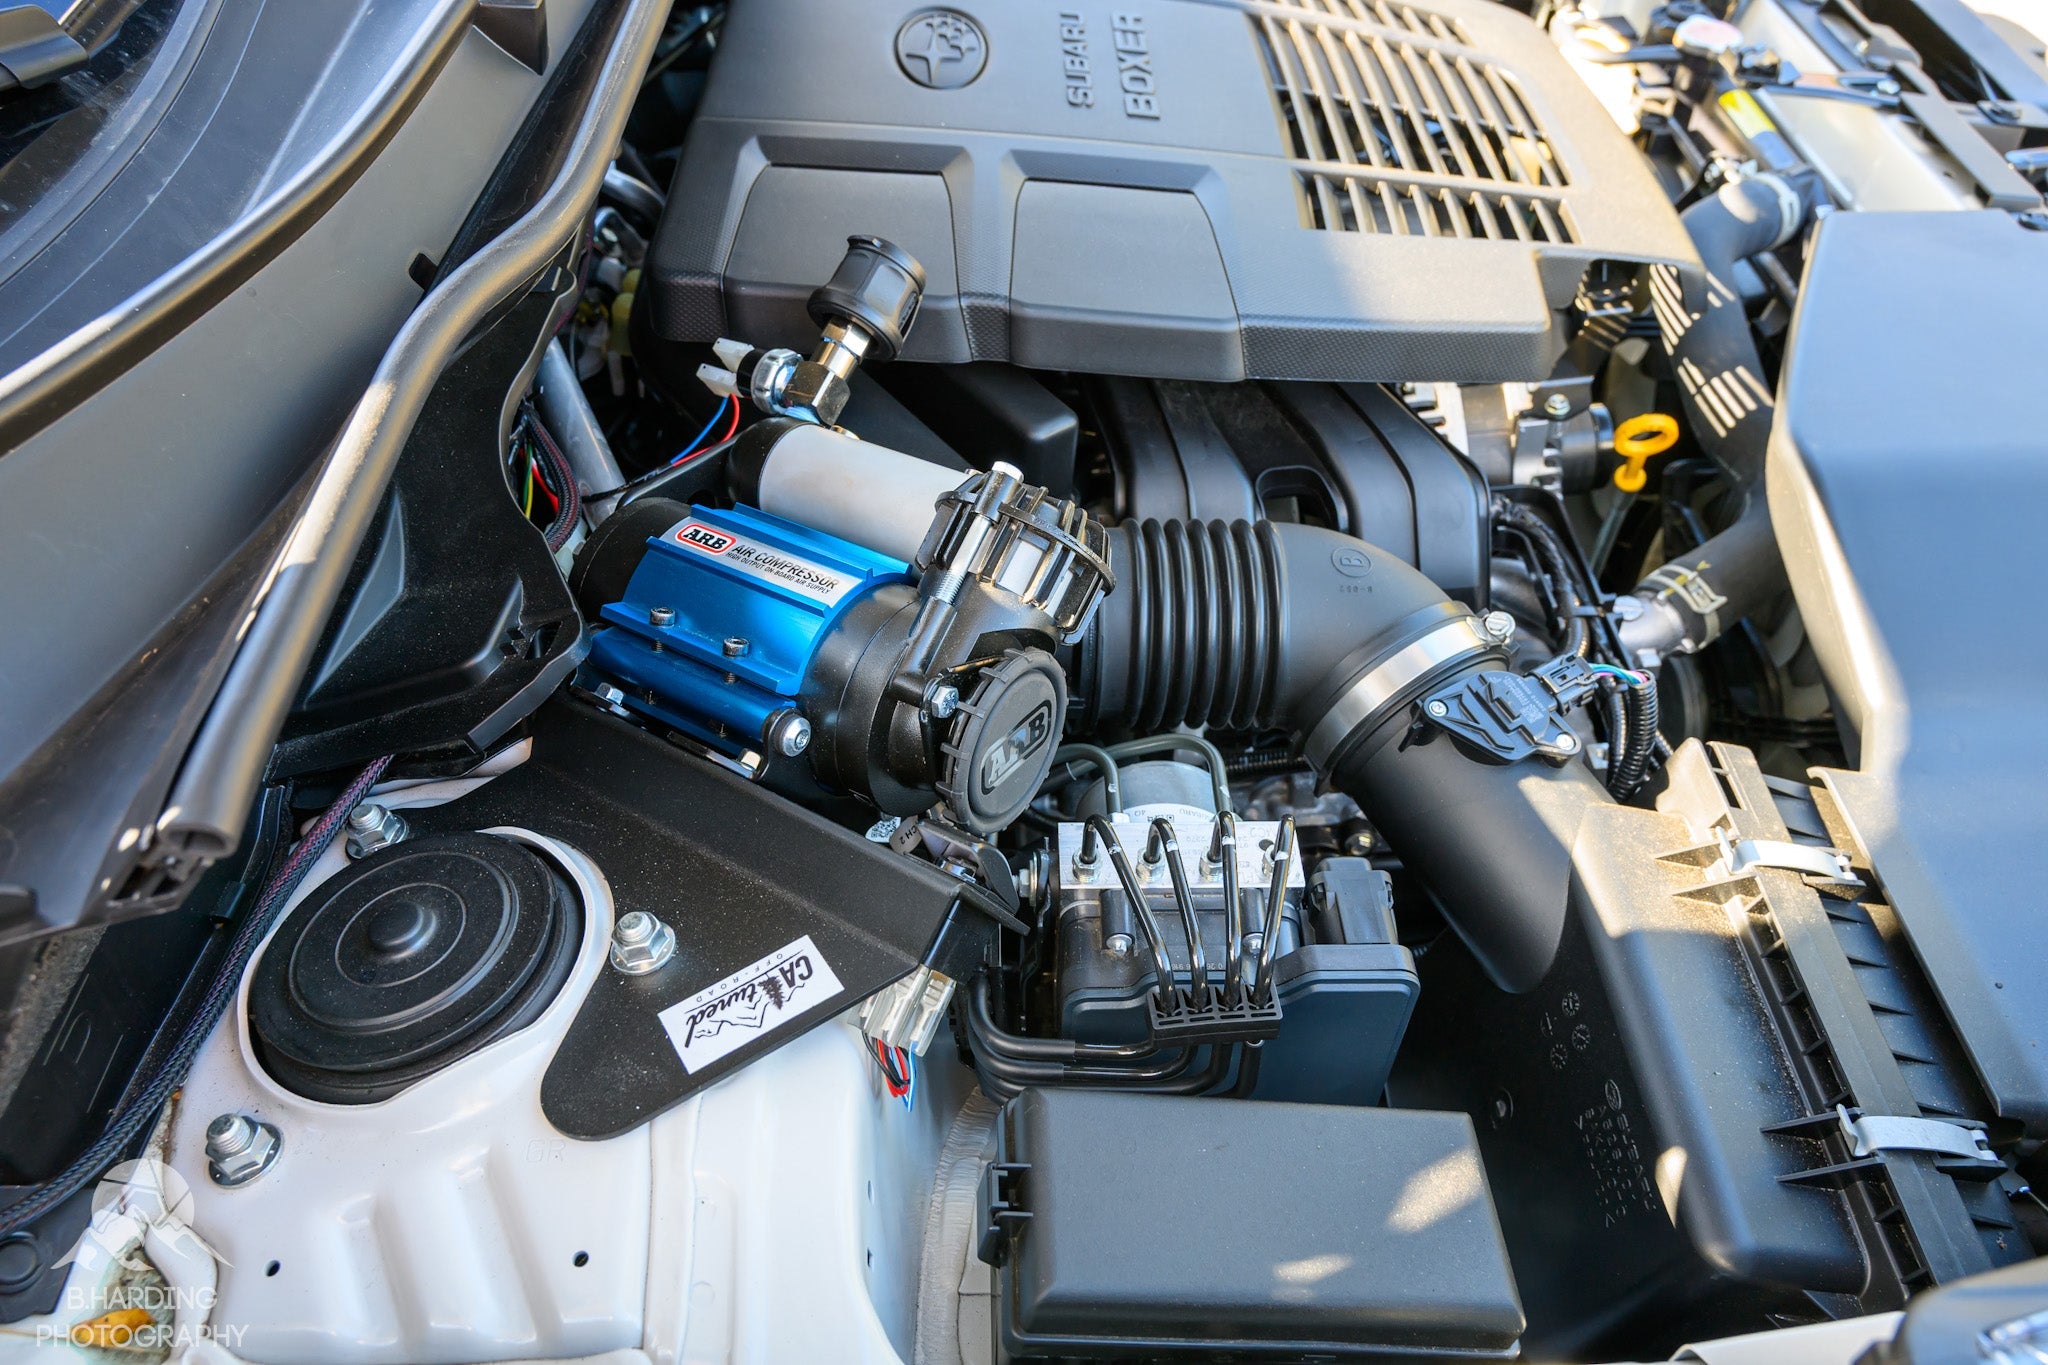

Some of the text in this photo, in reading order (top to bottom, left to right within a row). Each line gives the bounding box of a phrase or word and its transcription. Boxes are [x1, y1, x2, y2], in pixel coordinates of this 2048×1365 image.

[1059, 10, 1095, 109] SUBARU
[1110, 9, 1161, 121] BOXER
[683, 528, 728, 550] ARB
[733, 544, 839, 590] AIR COMPRESSOR
[725, 552, 831, 595] HIGH OUTPUT ON-BOARD AIR SUPPLY
[988, 711, 1046, 786] ARB
[684, 954, 814, 1049] CA tuned
[696, 952, 783, 1003] OFF-ROAD
